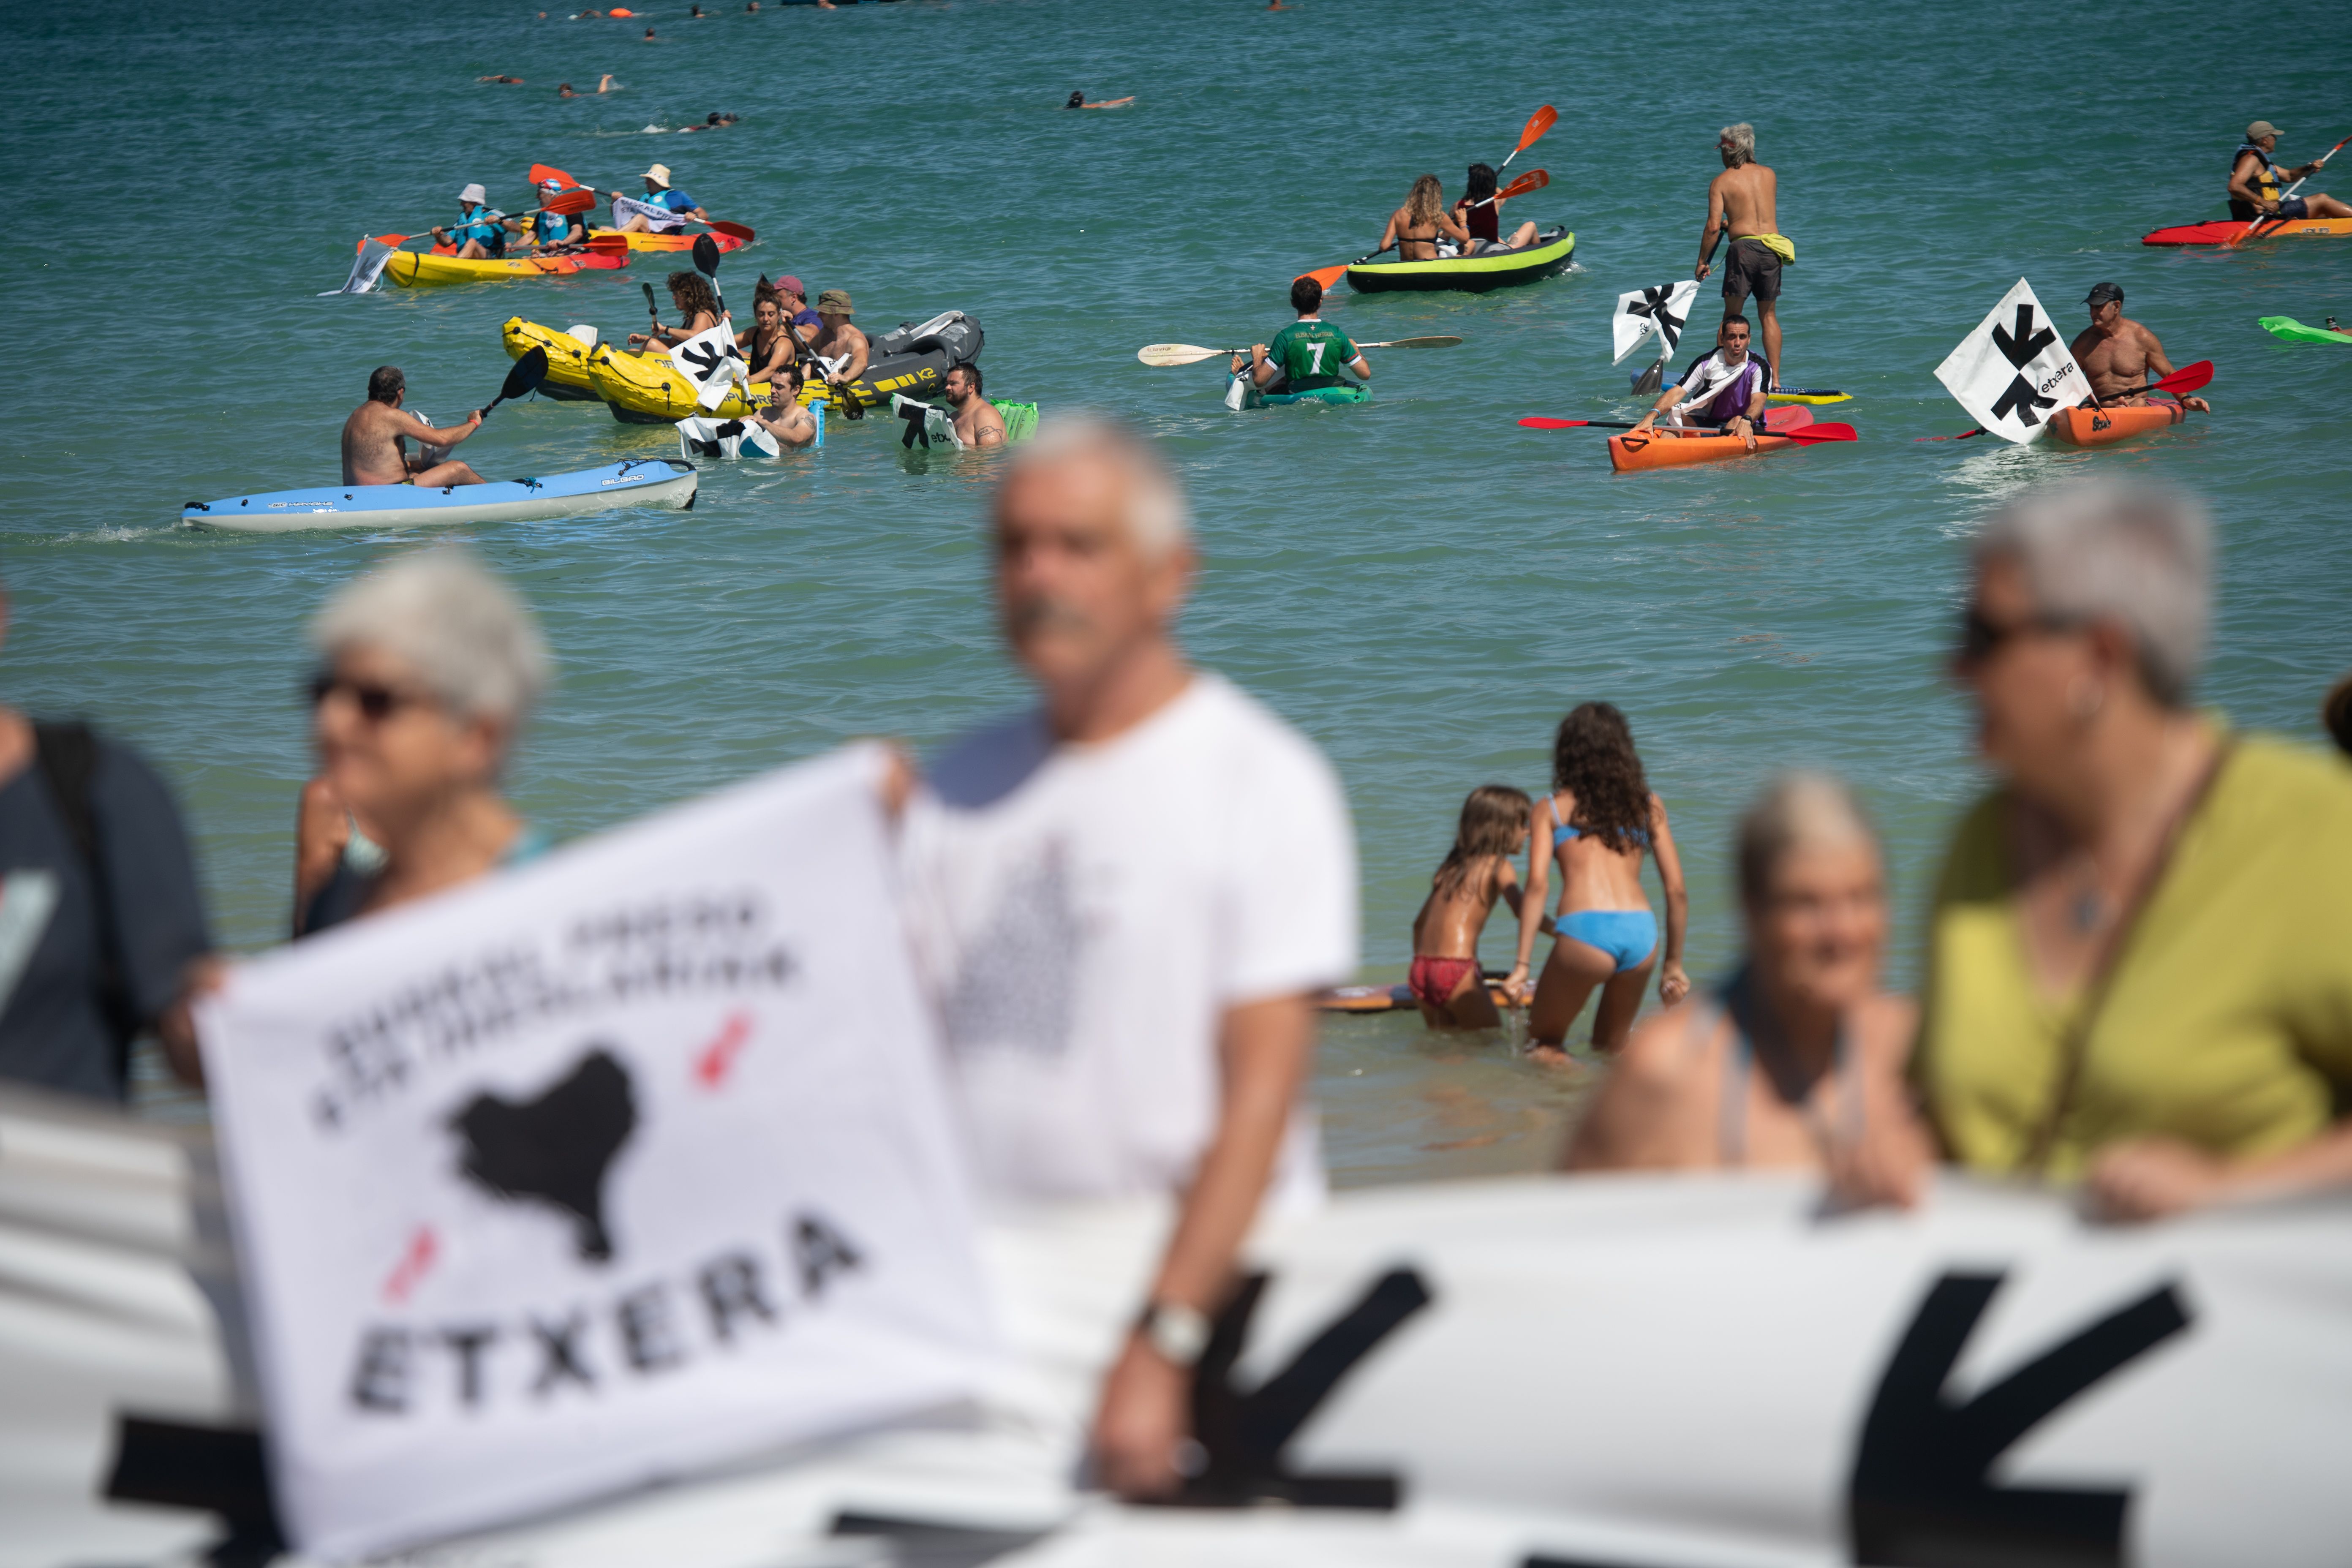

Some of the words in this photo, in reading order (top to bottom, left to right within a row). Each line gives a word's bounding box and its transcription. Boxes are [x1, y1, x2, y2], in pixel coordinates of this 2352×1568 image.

[1307, 342, 1326, 374] 7
[916, 367, 937, 381] K2
[2042, 362, 2074, 393] etxera
[350, 1211, 866, 1417] ETXERA
